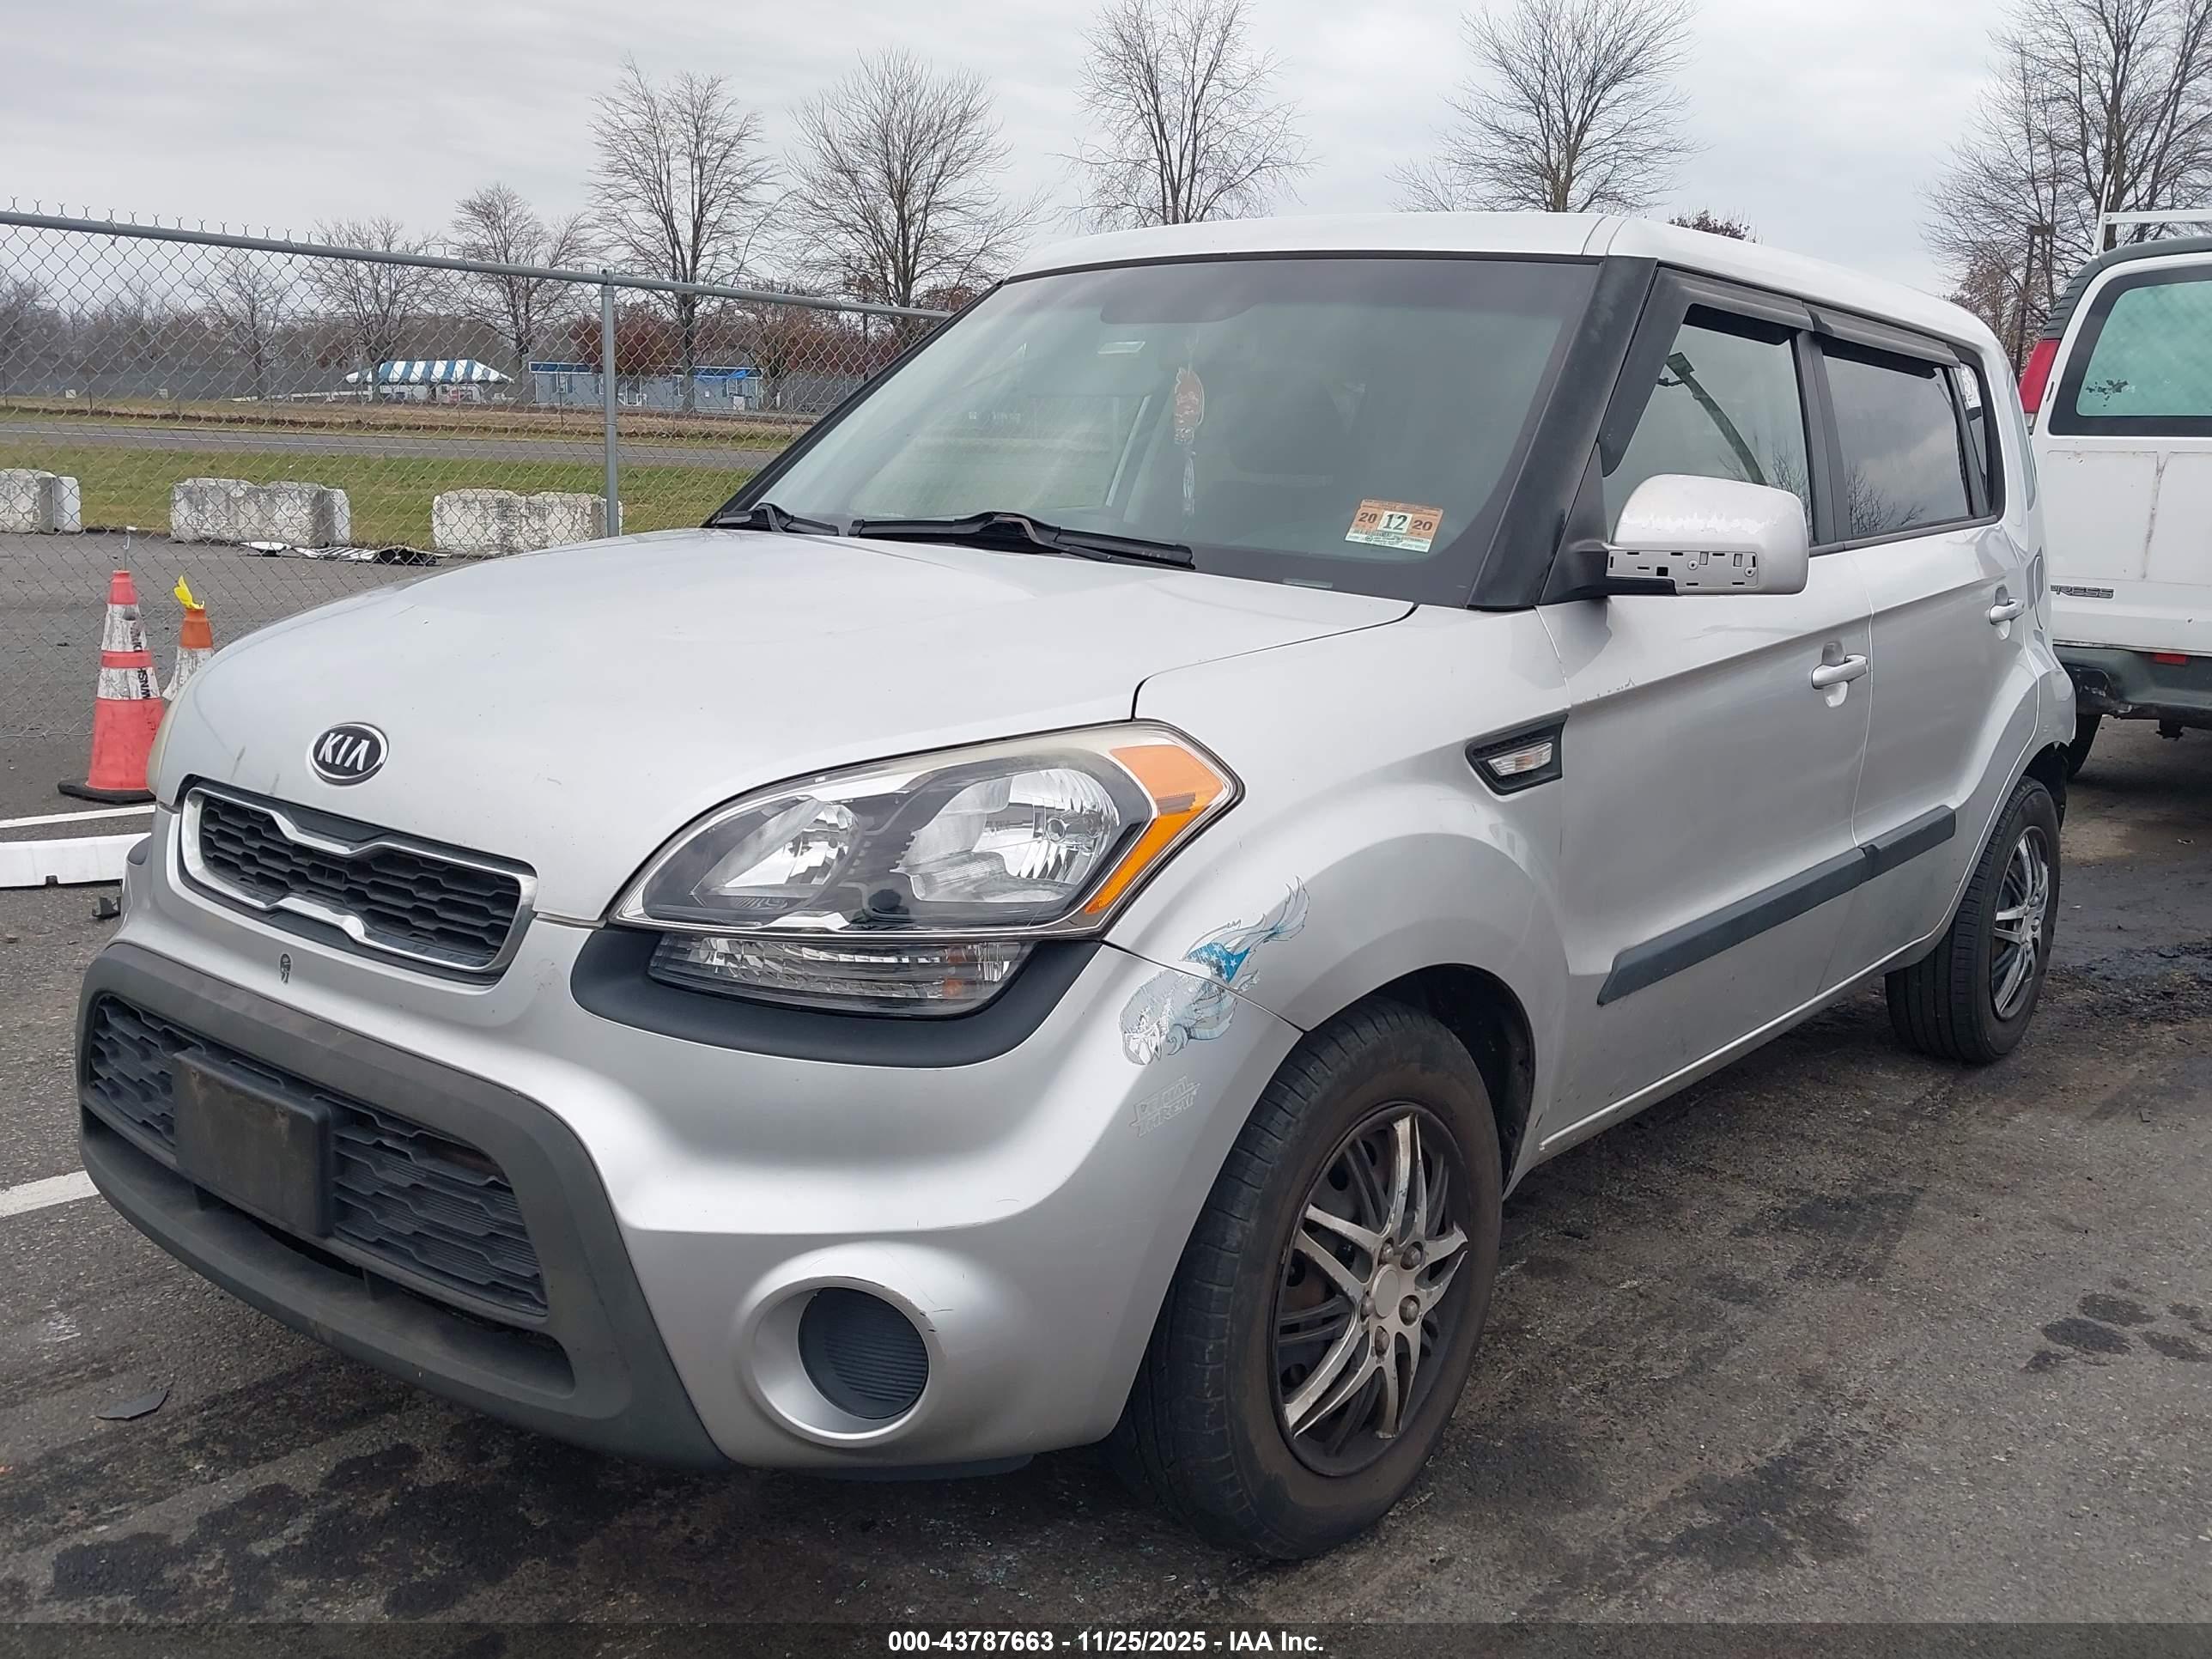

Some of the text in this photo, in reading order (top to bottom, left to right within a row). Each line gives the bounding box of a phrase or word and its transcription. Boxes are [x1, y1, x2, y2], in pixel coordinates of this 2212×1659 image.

[1358, 513, 1432, 531] 20 12 20
[318, 732, 370, 771] KIA
